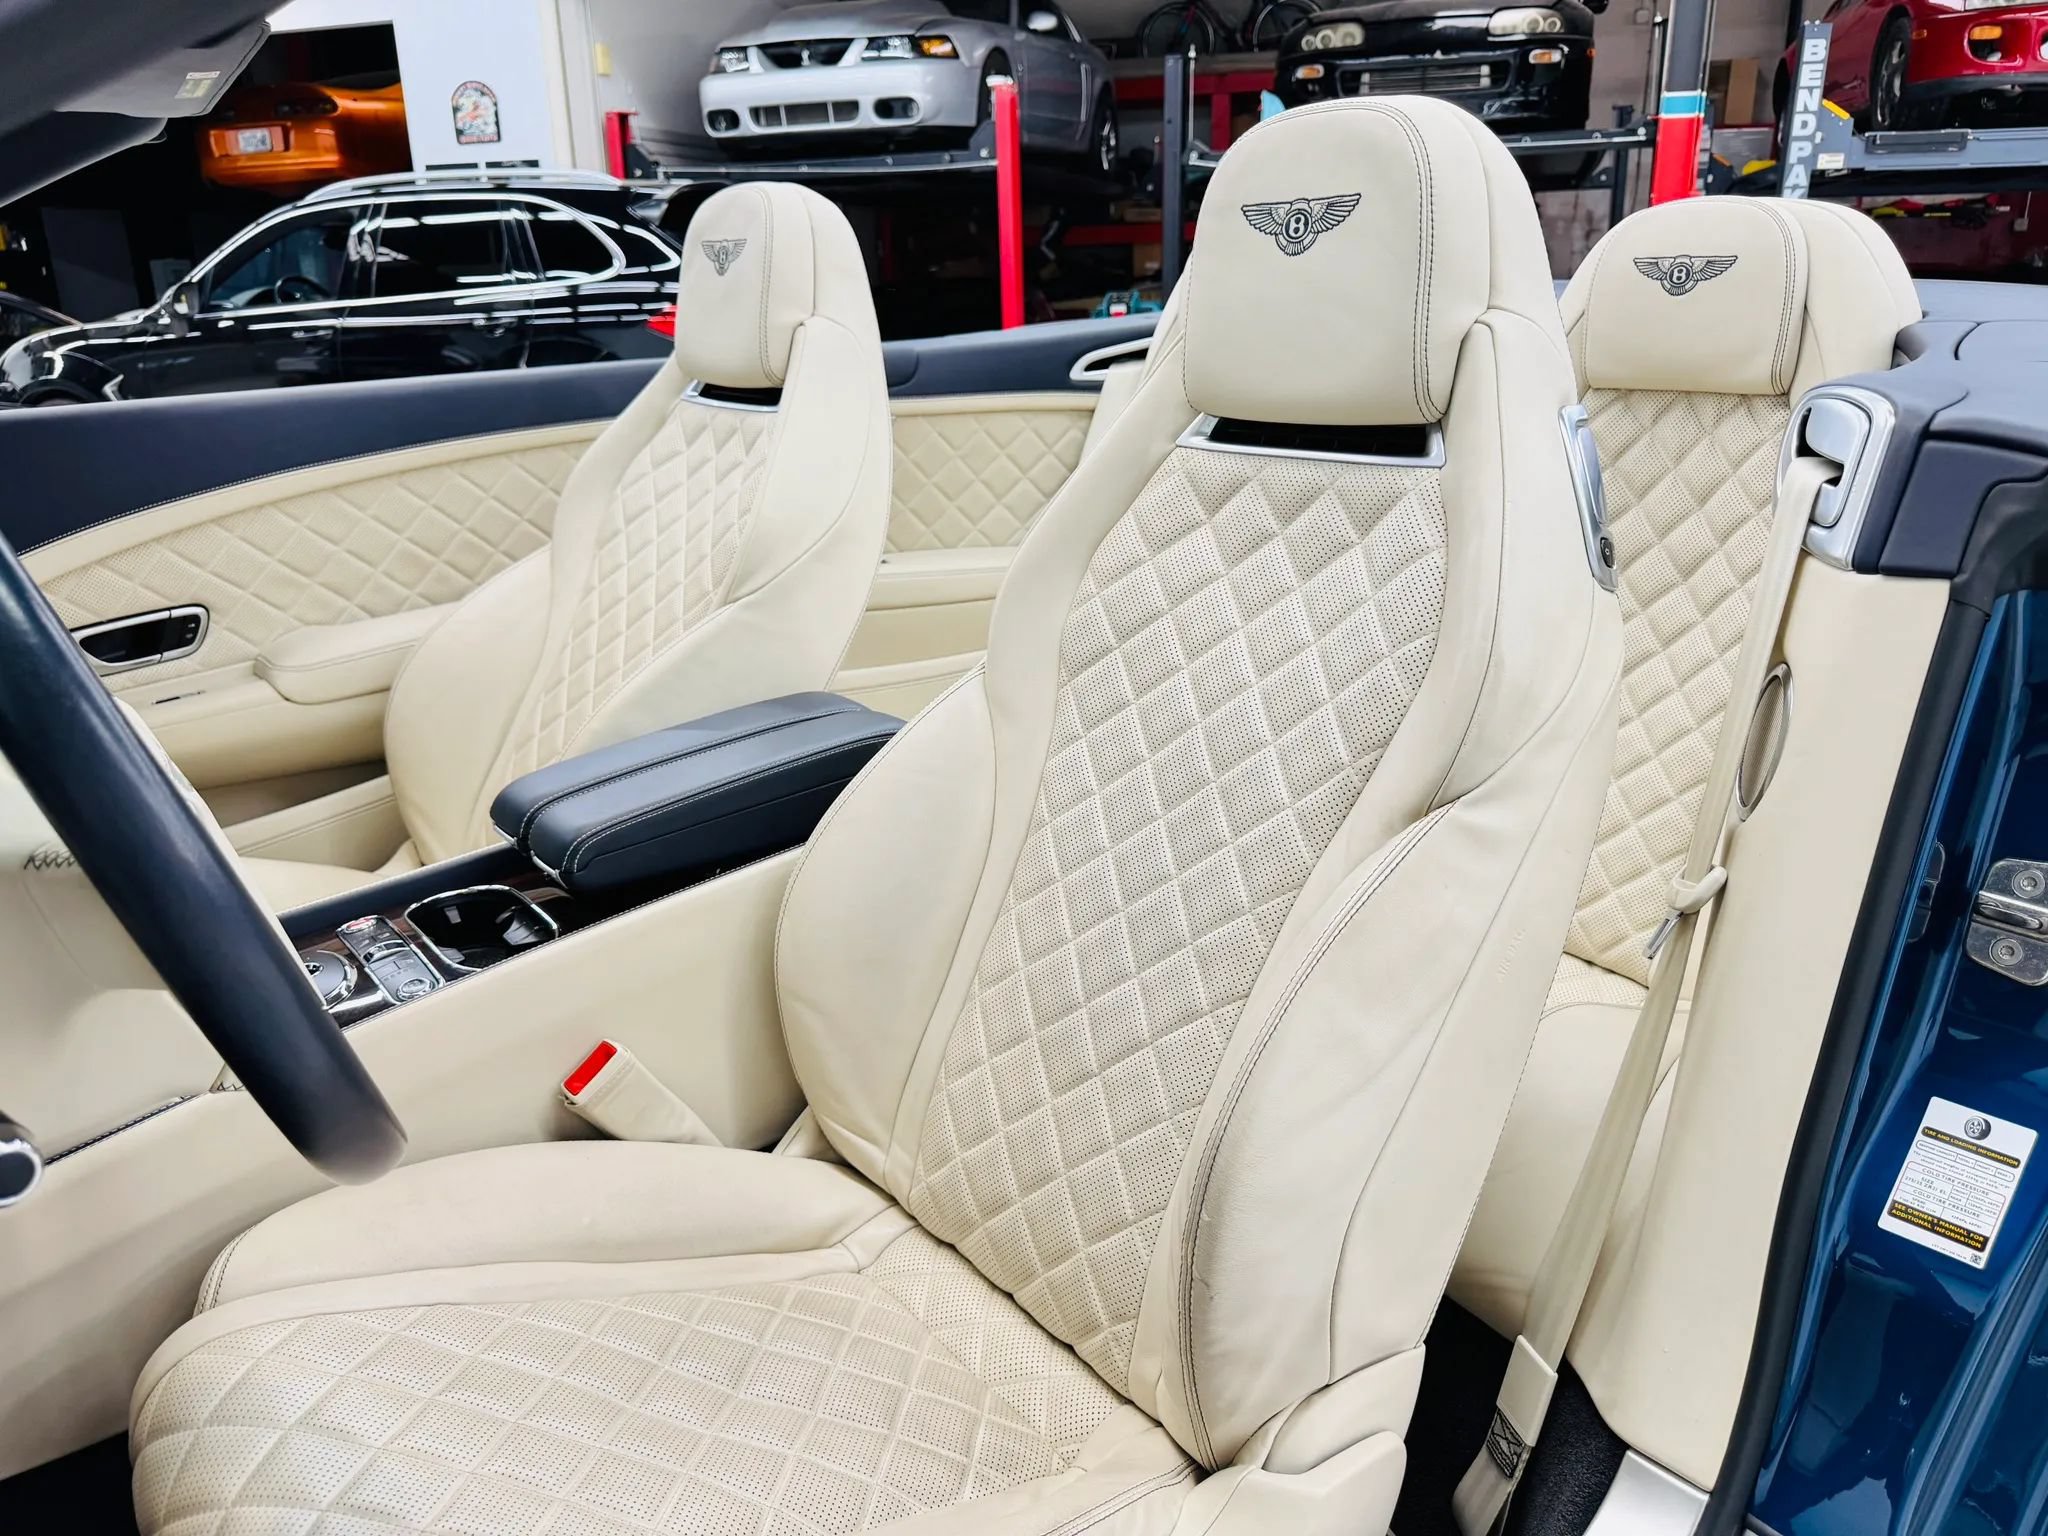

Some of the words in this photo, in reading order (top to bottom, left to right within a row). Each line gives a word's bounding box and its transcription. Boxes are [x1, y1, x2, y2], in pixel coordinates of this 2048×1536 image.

[1924, 1128, 1936, 1136] TIRE
[1936, 1133, 1949, 1141] AND
[1950, 1138, 1976, 1151] LOADING
[1977, 1148, 2018, 1166] INFORMATION
[1920, 1176, 1934, 1185] SIZE
[1921, 1168, 1940, 1178] COLD
[1941, 1175, 1955, 1183] TIRE
[1957, 1181, 1989, 1196] PRESSURE
[1912, 1189, 1930, 1199] COLD
[1931, 1196, 1946, 1205] TIRE
[1947, 1202, 1980, 1218] PRESSURE
[1891, 1208, 1932, 1228] ADDITIONAL
[1933, 1225, 1981, 1248] INFORMATION
[1894, 1202, 1905, 1211] SEE
[1906, 1207, 1938, 1223] OWNER'S
[1938, 1220, 1968, 1235] MANUAL
[1969, 1232, 1984, 1241] FOR
